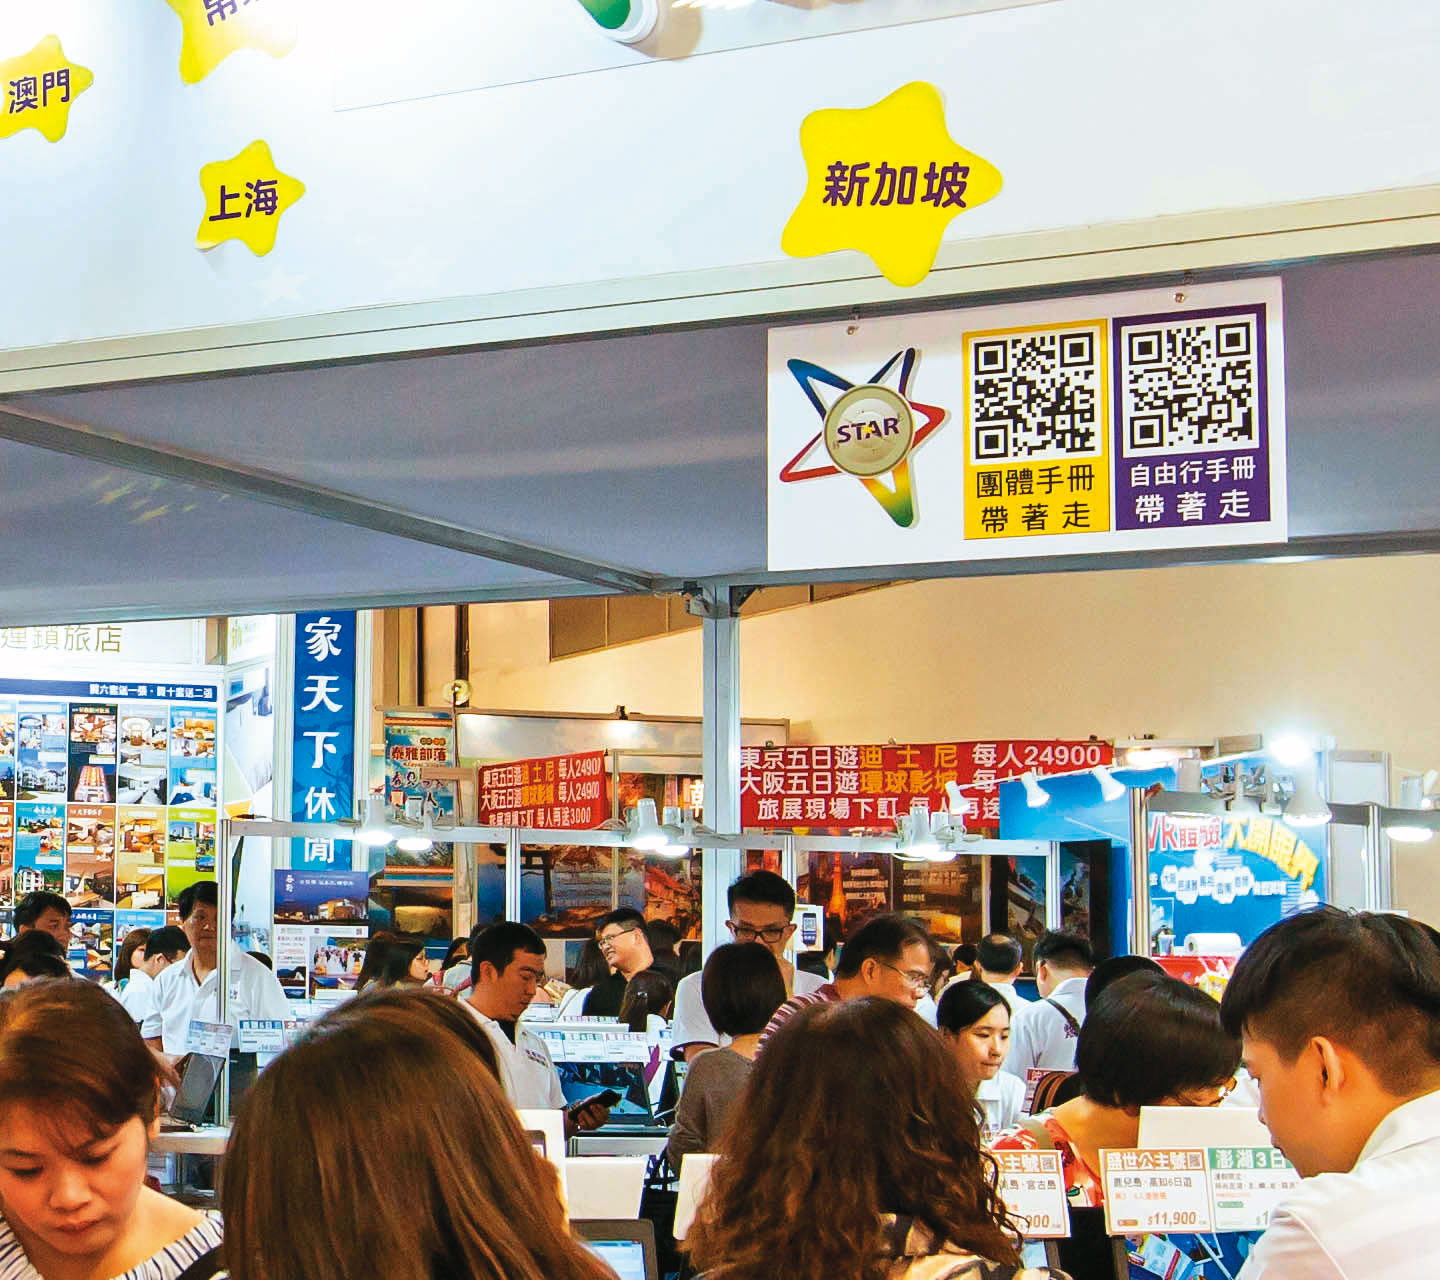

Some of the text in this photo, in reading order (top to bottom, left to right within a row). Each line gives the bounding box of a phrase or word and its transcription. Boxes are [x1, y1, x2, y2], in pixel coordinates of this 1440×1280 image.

[7, 69, 72, 117] 澳門
[207, 176, 280, 224] 上海
[821, 158, 971, 212] 新加坡
[834, 414, 901, 447] STAR
[975, 463, 1096, 500] 團體手冊
[1128, 451, 1256, 488] 自由行手冊
[980, 497, 1093, 533] 帶著走
[1134, 489, 1251, 523] 帶著走
[389, 745, 447, 762] 泰雅部落
[971, 742, 1101, 769] 每人24900
[757, 797, 899, 821] 旅展現場下訂
